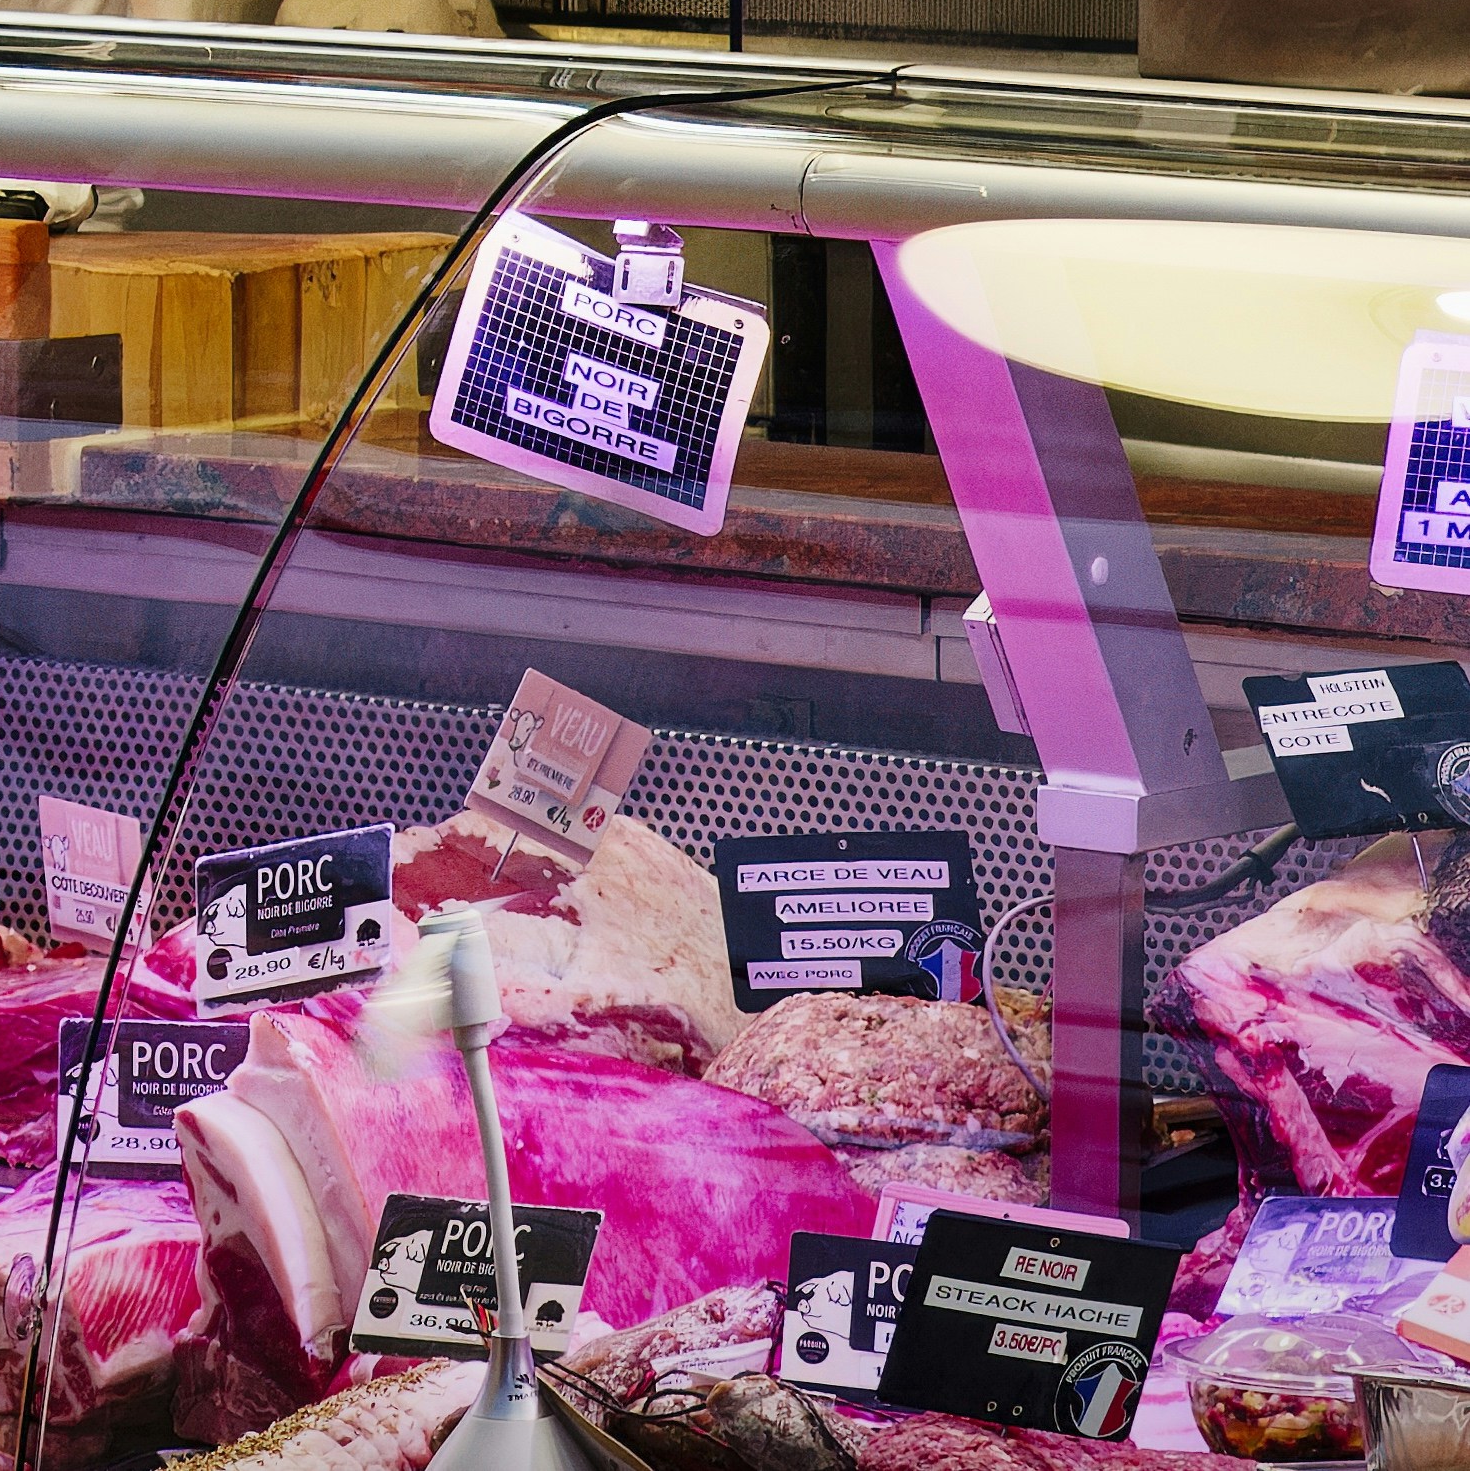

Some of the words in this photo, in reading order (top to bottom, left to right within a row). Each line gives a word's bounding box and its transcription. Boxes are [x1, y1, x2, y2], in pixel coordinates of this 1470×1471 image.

[573, 291, 658, 337] PORC
[570, 361, 648, 401] NOIR
[579, 392, 624, 419] DE
[513, 397, 660, 462] BIGORRE
[1320, 679, 1385, 695] HOLSTEIN
[549, 703, 608, 758] VEAU
[1278, 733, 1340, 749] COTE
[70, 819, 113, 862] VEAU
[257, 854, 334, 904] PORC
[739, 868, 826, 884] FARCE
[834, 867, 869, 880] DE
[876, 867, 944, 880] VEAU
[257, 907, 280, 921] NOIR
[281, 903, 294, 917] DE
[295, 894, 333, 914] BIGORRE
[779, 900, 930, 915] AMELIOREE
[787, 936, 897, 952] 15.50/KG
[234, 957, 292, 981] 28.90
[307, 946, 345, 971] €/kg
[753, 970, 799, 980] AVEC
[805, 969, 854, 979] PORC
[132, 1041, 227, 1081] PORC
[132, 1081, 160, 1095] NOIR
[162, 1083, 177, 1096] DE
[436, 1258, 461, 1273] NOIR
[462, 1260, 477, 1275] DE
[1039, 1259, 1078, 1282] NOIR
[866, 1303, 896, 1320] NOIR
[935, 1284, 1037, 1314] STEACK
[1044, 1302, 1131, 1328] HACHE
[1065, 1348, 1100, 1384] PRODUIT
